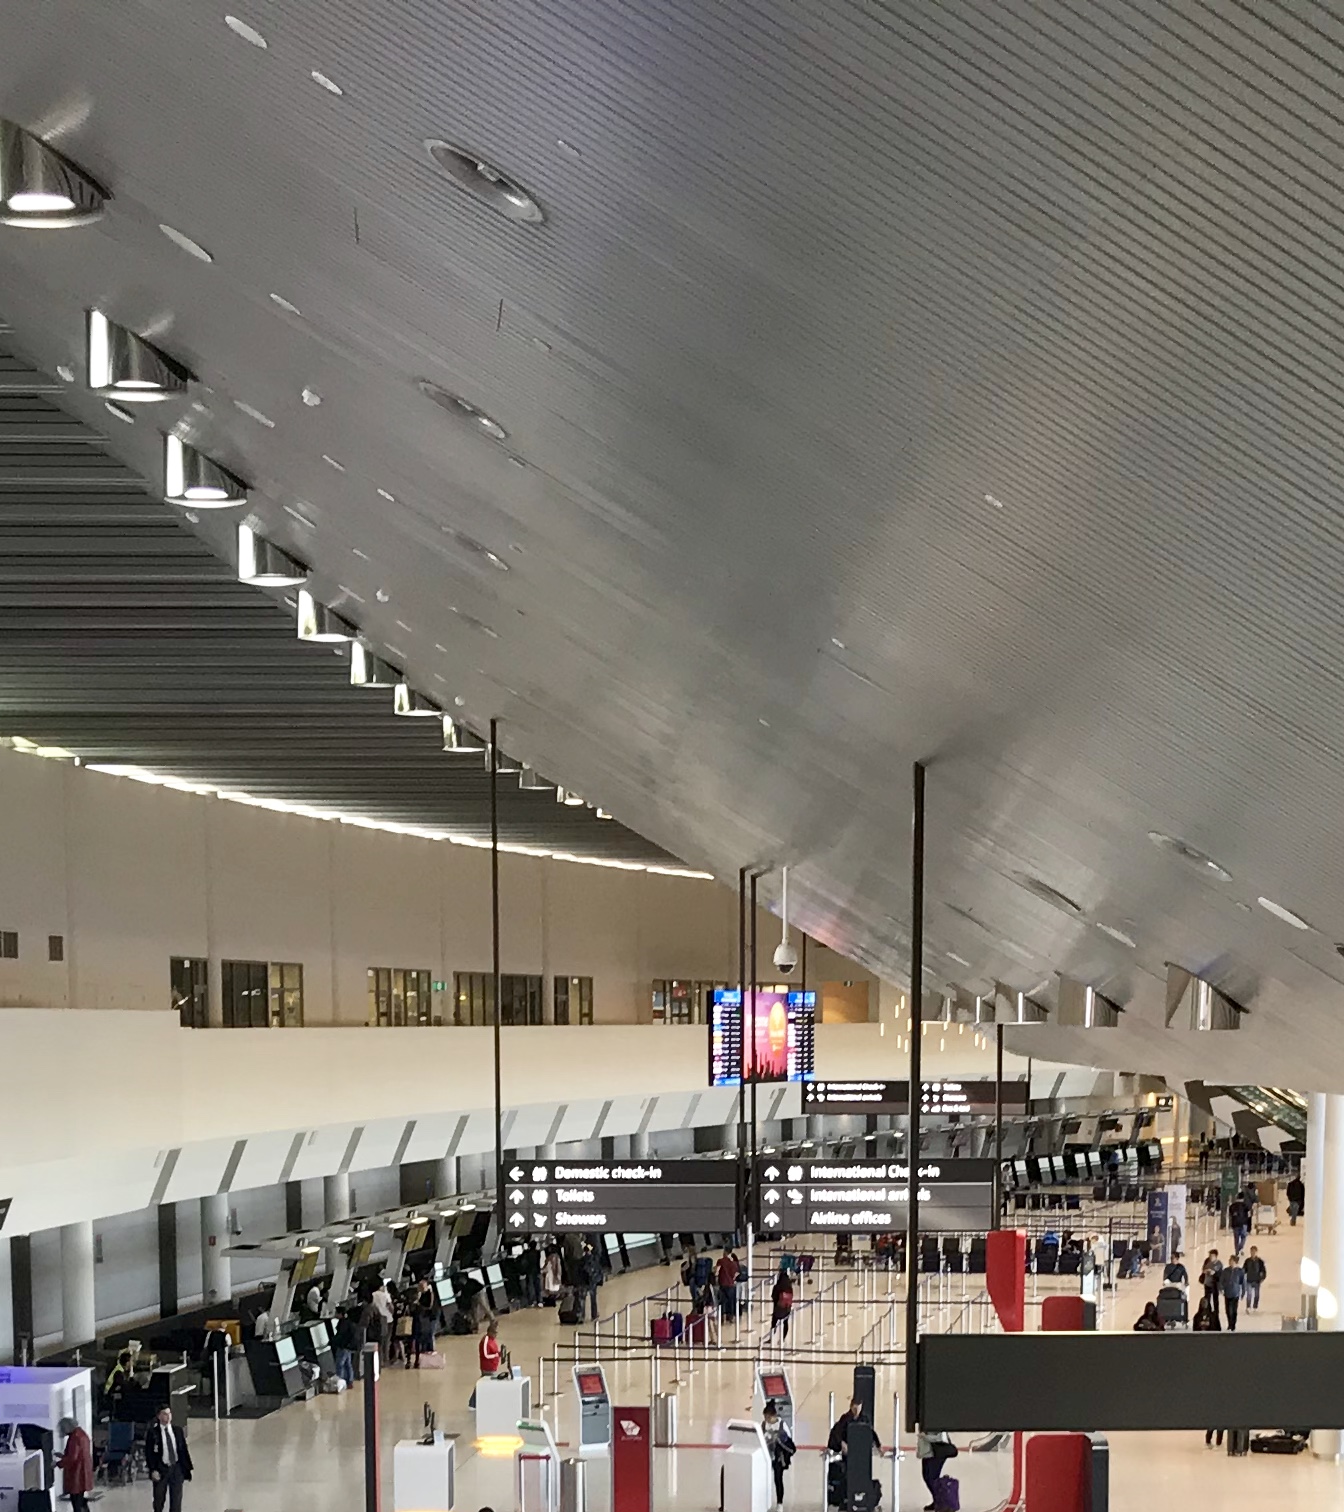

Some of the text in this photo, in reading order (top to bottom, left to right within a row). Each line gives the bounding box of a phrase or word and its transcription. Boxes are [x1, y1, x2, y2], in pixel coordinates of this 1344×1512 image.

[555, 1166, 662, 1179] Domestic check-in
[810, 1165, 886, 1179] International
[556, 1189, 595, 1202] Toilets
[810, 1188, 886, 1201] International
[556, 1212, 606, 1225] Showers
[810, 1211, 891, 1224] Airline offices
